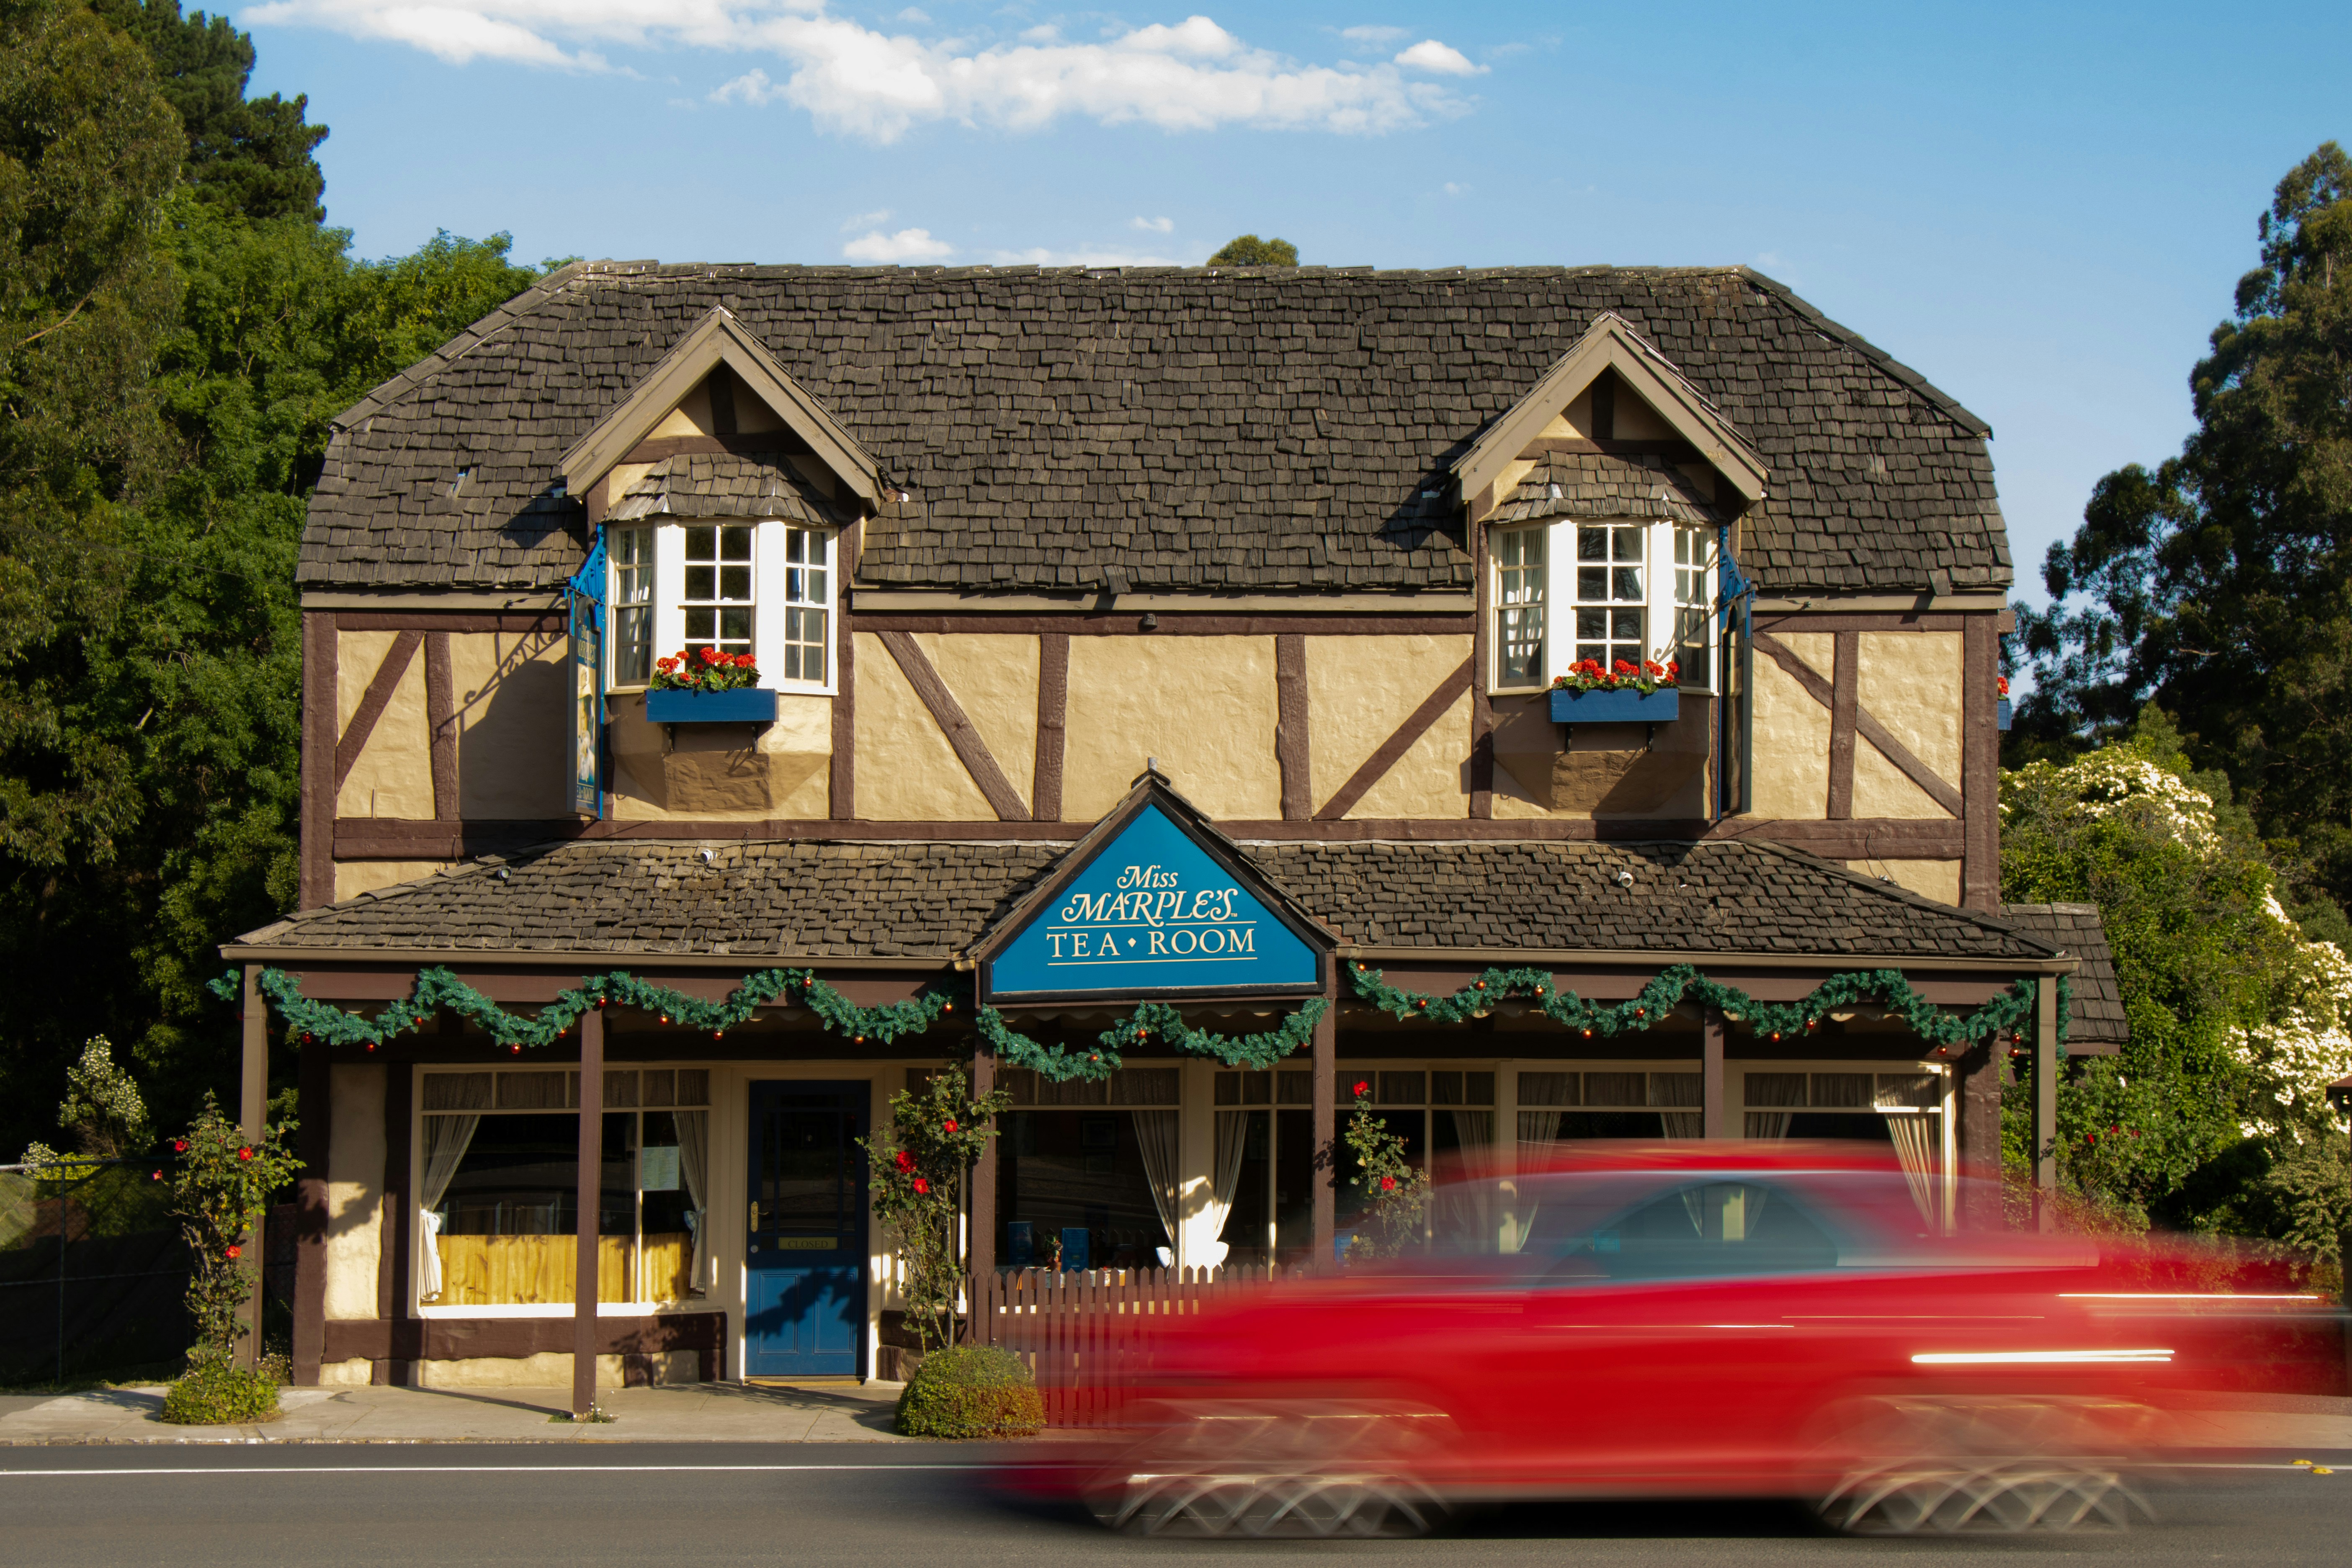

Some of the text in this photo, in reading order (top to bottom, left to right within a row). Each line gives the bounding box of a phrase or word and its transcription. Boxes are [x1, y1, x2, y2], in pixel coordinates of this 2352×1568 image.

[1116, 865, 1179, 889] Miss
[1061, 888, 1238, 927] MARPLE'S
[1046, 928, 1255, 958] TEA ROOM
[788, 1240, 828, 1249] CLOSED
